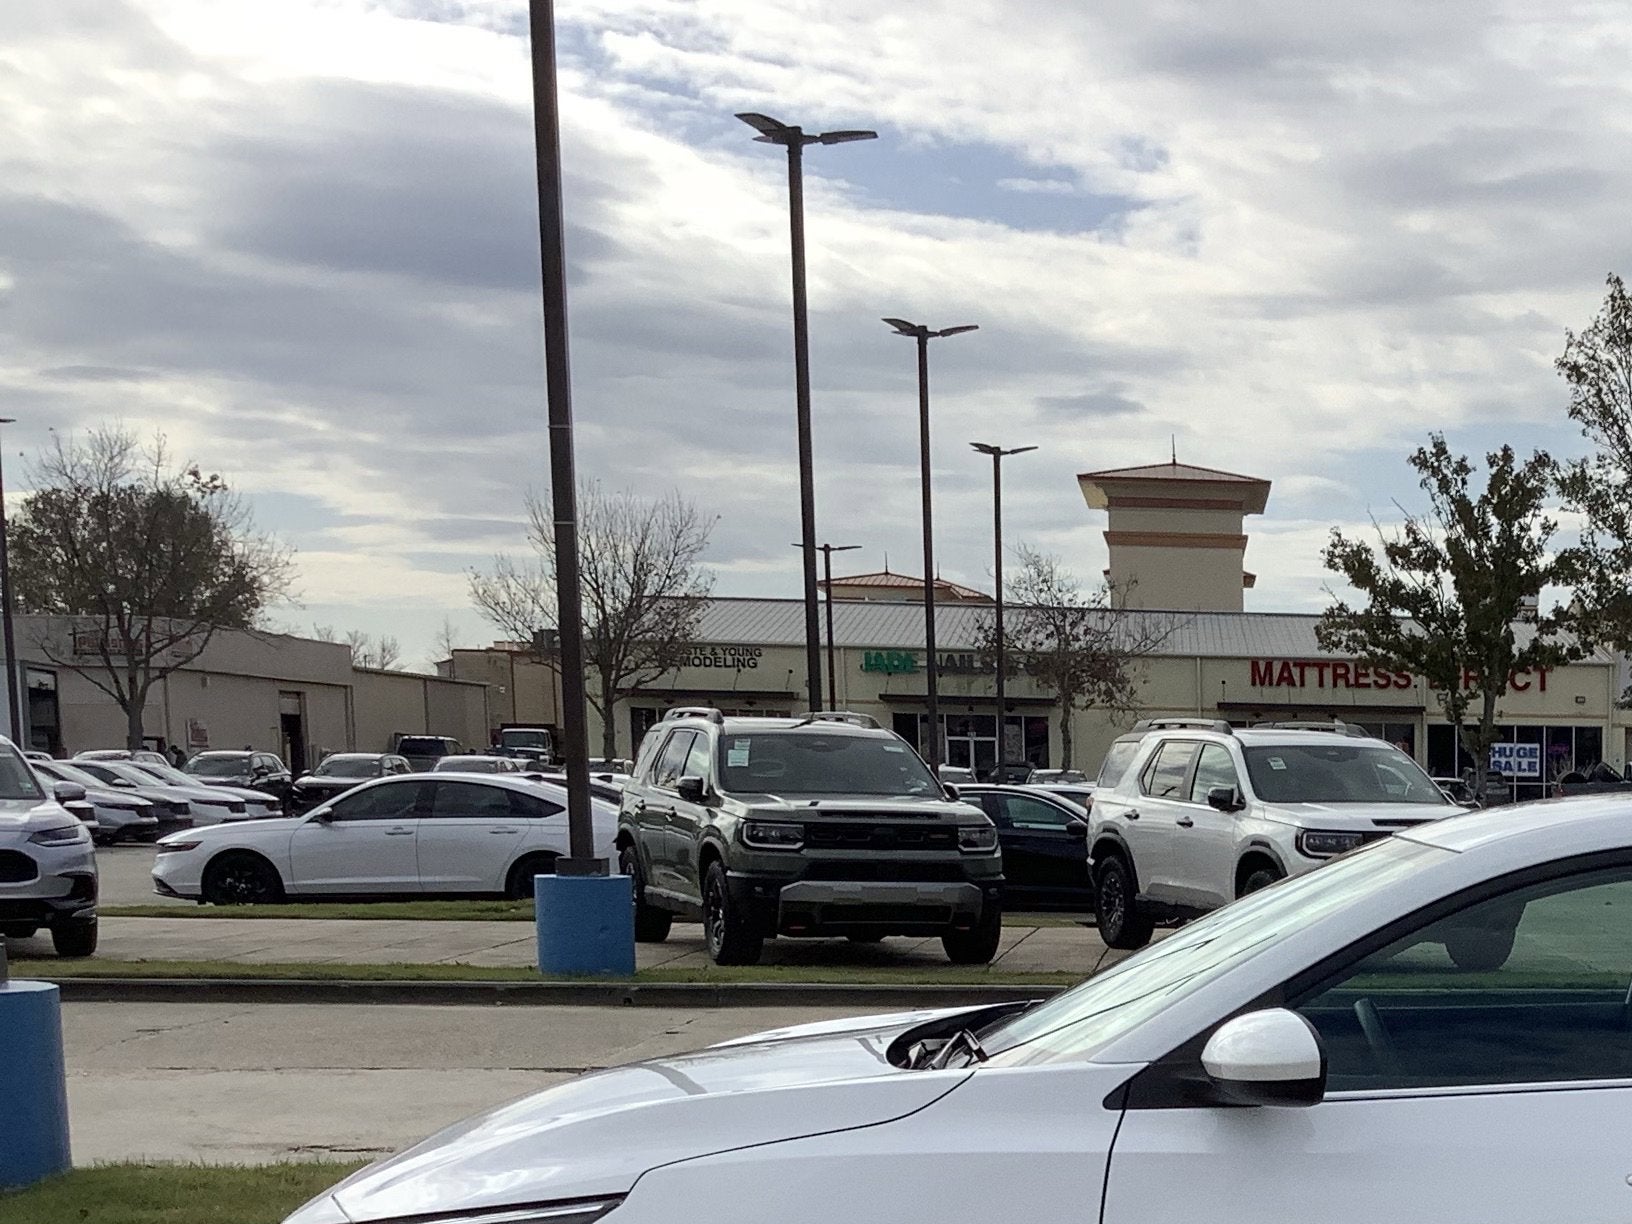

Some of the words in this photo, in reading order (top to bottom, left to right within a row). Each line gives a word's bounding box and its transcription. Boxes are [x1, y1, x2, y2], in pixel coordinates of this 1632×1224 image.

[720, 647, 762, 657] YOUNG
[1250, 660, 1412, 690] MATTRESS
[1428, 665, 1554, 692] RCT
[1491, 746, 1539, 759] HUGE
[1491, 760, 1538, 773] SALE
